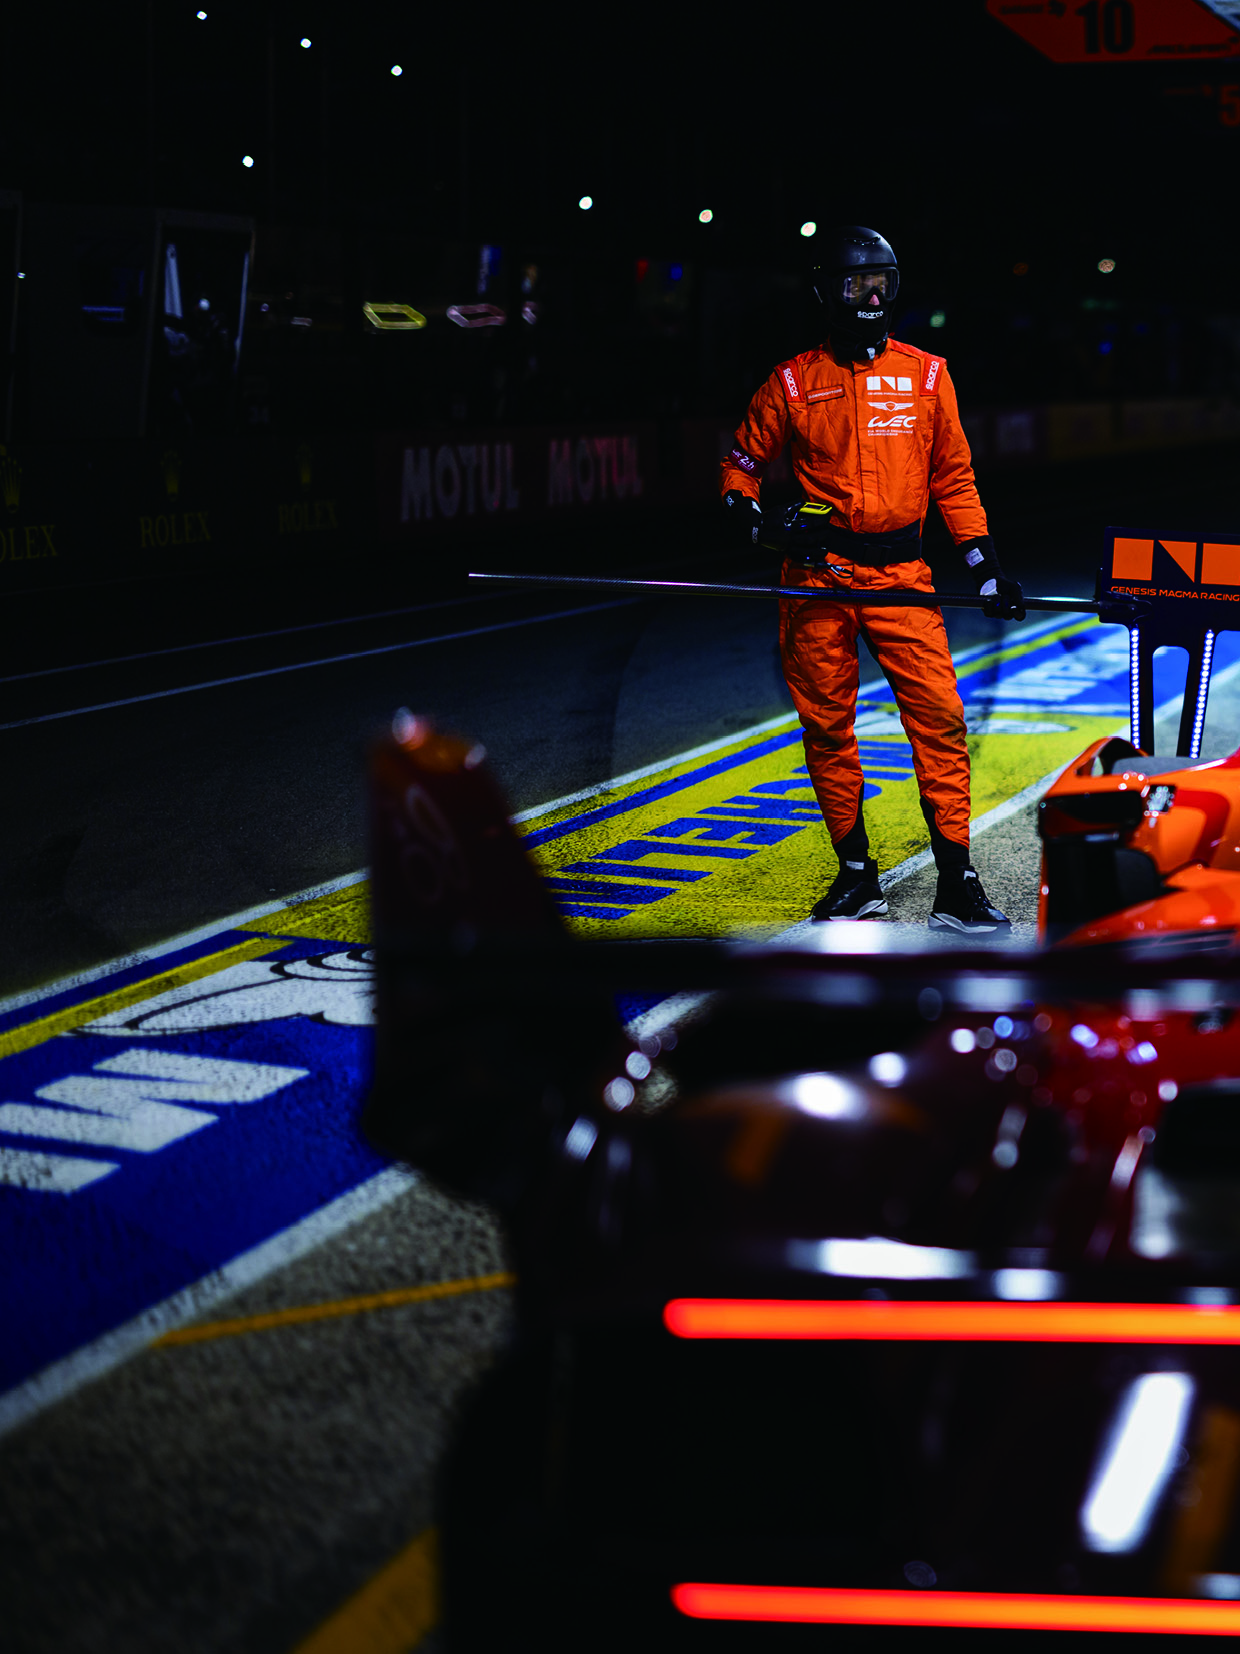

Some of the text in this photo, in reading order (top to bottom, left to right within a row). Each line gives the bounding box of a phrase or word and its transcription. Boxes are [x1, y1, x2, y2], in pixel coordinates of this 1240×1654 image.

[1074, 0, 1135, 54] 10
[782, 367, 799, 398] sparco
[925, 360, 940, 391] sparco
[867, 415, 917, 428] WEC
[401, 443, 520, 523] MOTUL
[549, 434, 643, 505] MOTUL
[139, 511, 212, 548] ROLEX
[277, 499, 339, 535] ROLEX
[1110, 585, 1240, 602] GENESIS MAGMA RACING
